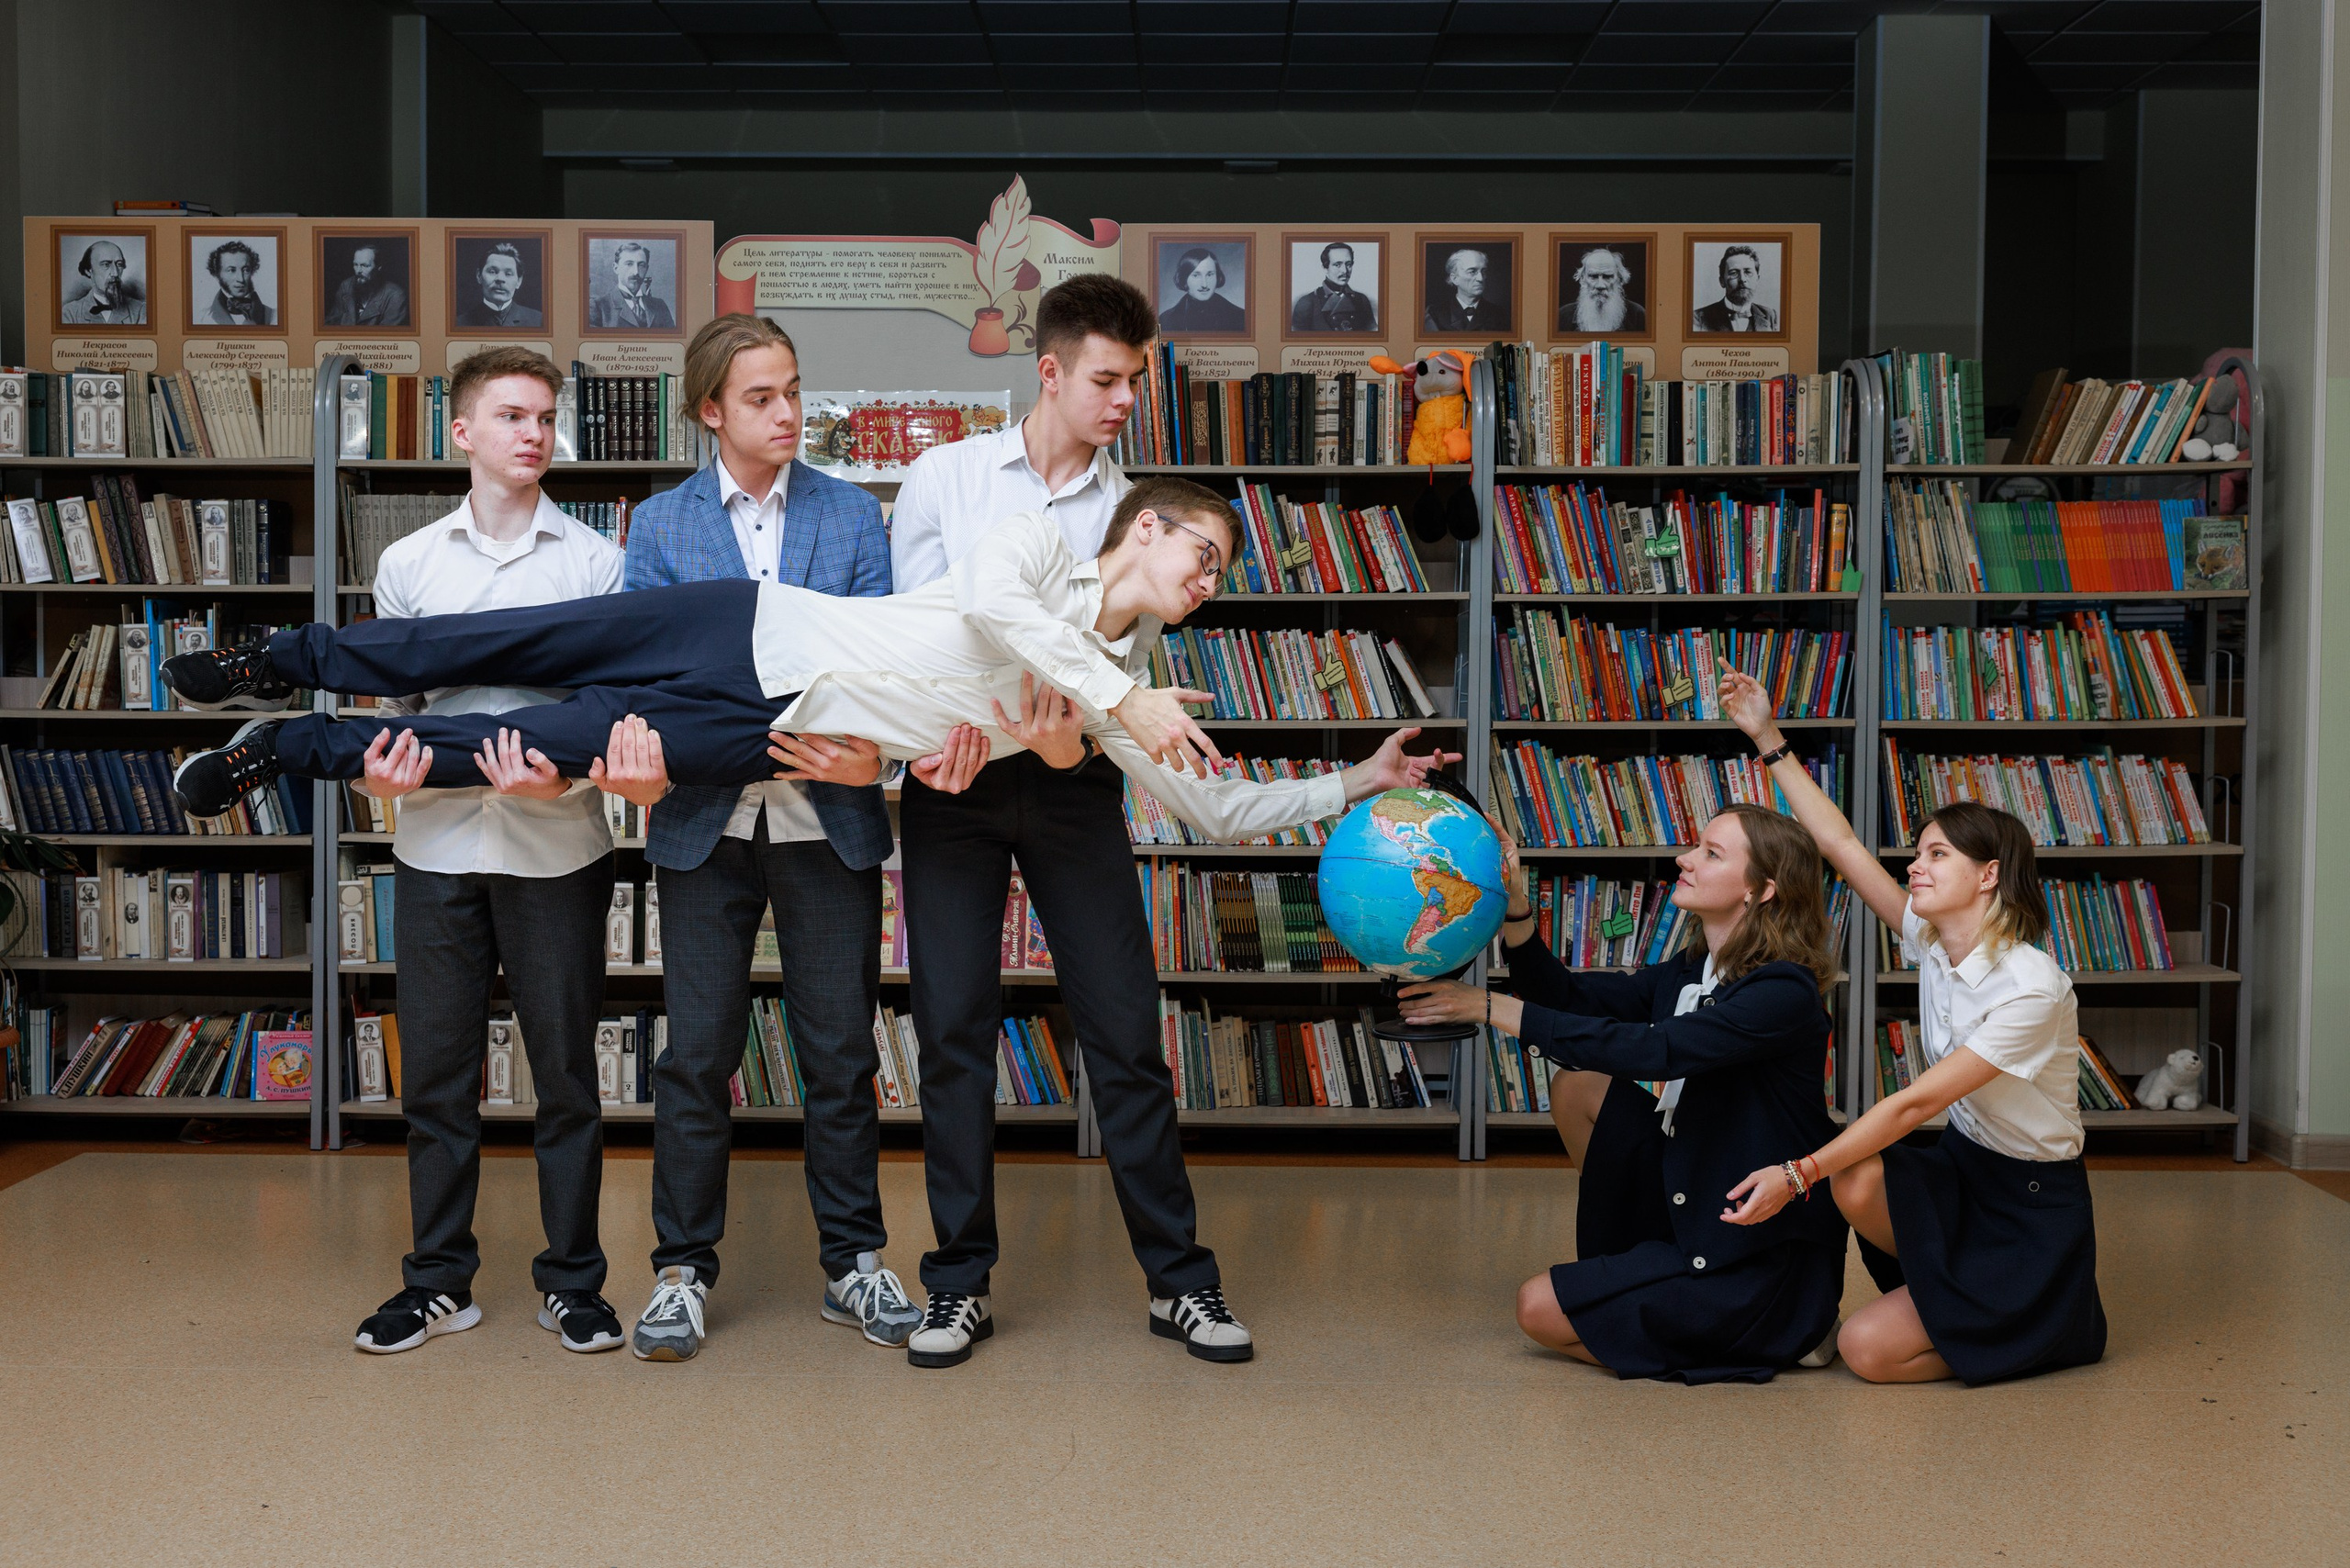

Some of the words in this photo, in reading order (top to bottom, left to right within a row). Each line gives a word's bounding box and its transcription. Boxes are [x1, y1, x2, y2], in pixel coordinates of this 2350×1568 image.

[743, 249, 766, 258] Цель
[769, 249, 823, 258] литературы
[833, 249, 874, 258] помогать
[877, 249, 917, 258] человеку
[919, 249, 962, 258] понимать
[1044, 253, 1095, 264] Максим
[760, 282, 810, 290] пошлостью
[820, 282, 850, 290] людях,
[852, 282, 882, 290] уметь
[884, 282, 912, 290] найти
[914, 282, 951, 290] хорошее
[962, 282, 980, 290] них,
[760, 292, 814, 300] возбуждать
[839, 292, 867, 300] душах
[870, 292, 895, 300] стыд,
[898, 292, 920, 300] гнев,
[924, 292, 975, 300] мужество...
[82, 341, 127, 350] Некрасов
[216, 342, 256, 351] Пушкин
[335, 342, 399, 351] Достоевский
[617, 344, 647, 353] Бунин
[56, 349, 98, 359] Николай
[100, 350, 153, 359] Алексеевич
[186, 351, 237, 361] Александр
[239, 351, 285, 361] Сергеевич
[355, 352, 413, 360] Михайлович
[592, 354, 616, 362] Иван
[618, 354, 672, 363] Алексеевич
[1185, 348, 1219, 357] Гоголь
[1304, 348, 1365, 358] Лермонтов
[1721, 348, 1751, 357] Чехов
[210, 360, 262, 370] (1799-1837)
[605, 363, 659, 372] (1870-1953)
[1691, 359, 1726, 367] Антон
[1729, 359, 1779, 368] Павлович
[1553, 358, 1562, 387] СКАЗОК
[1706, 369, 1765, 378] (1860-1904)
[1555, 389, 1563, 418] КНИГА
[1923, 392, 1931, 424] ЦЫФЕРОВ
[858, 416, 865, 428] В
[872, 416, 906, 428] МИРЕ
[2057, 428, 2074, 458] РАССКАЗЫ
[2073, 386, 2092, 421] ЖИВОТНЫХ
[1555, 420, 1564, 455] ЗОЛОТАЯ
[1582, 414, 1590, 449] ГРИММ
[857, 431, 954, 454] СКАЗОК
[1498, 495, 1509, 526] АНДЕРСЕН
[1509, 493, 1523, 532] СКАЗКИ
[1371, 513, 1382, 532] друзей
[1555, 537, 1565, 567] волшебные
[1516, 559, 1524, 583] Любимые
[1562, 569, 1571, 590] Лучшие
[1244, 639, 1253, 662] шкатулка
[1544, 637, 1552, 662] ПОППИНС
[1548, 662, 1559, 701] ВОЗВРАЩАЕТСЯ
[1249, 664, 1259, 694] Малахитовая
[1634, 885, 1642, 896] Пэн
[1631, 900, 1640, 920] Питер
[1009, 899, 1020, 967] МАМИН-СИБИРЯК
[270, 1042, 312, 1054] лукоморь
[55, 1066, 71, 1088] ЛУКОМОРЬЯ
[75, 1038, 91, 1057] ЗЕЛЁНЫЙ
[61, 1050, 94, 1096] А.ПУШКИН
[280, 1086, 312, 1094] ПУШКИН
